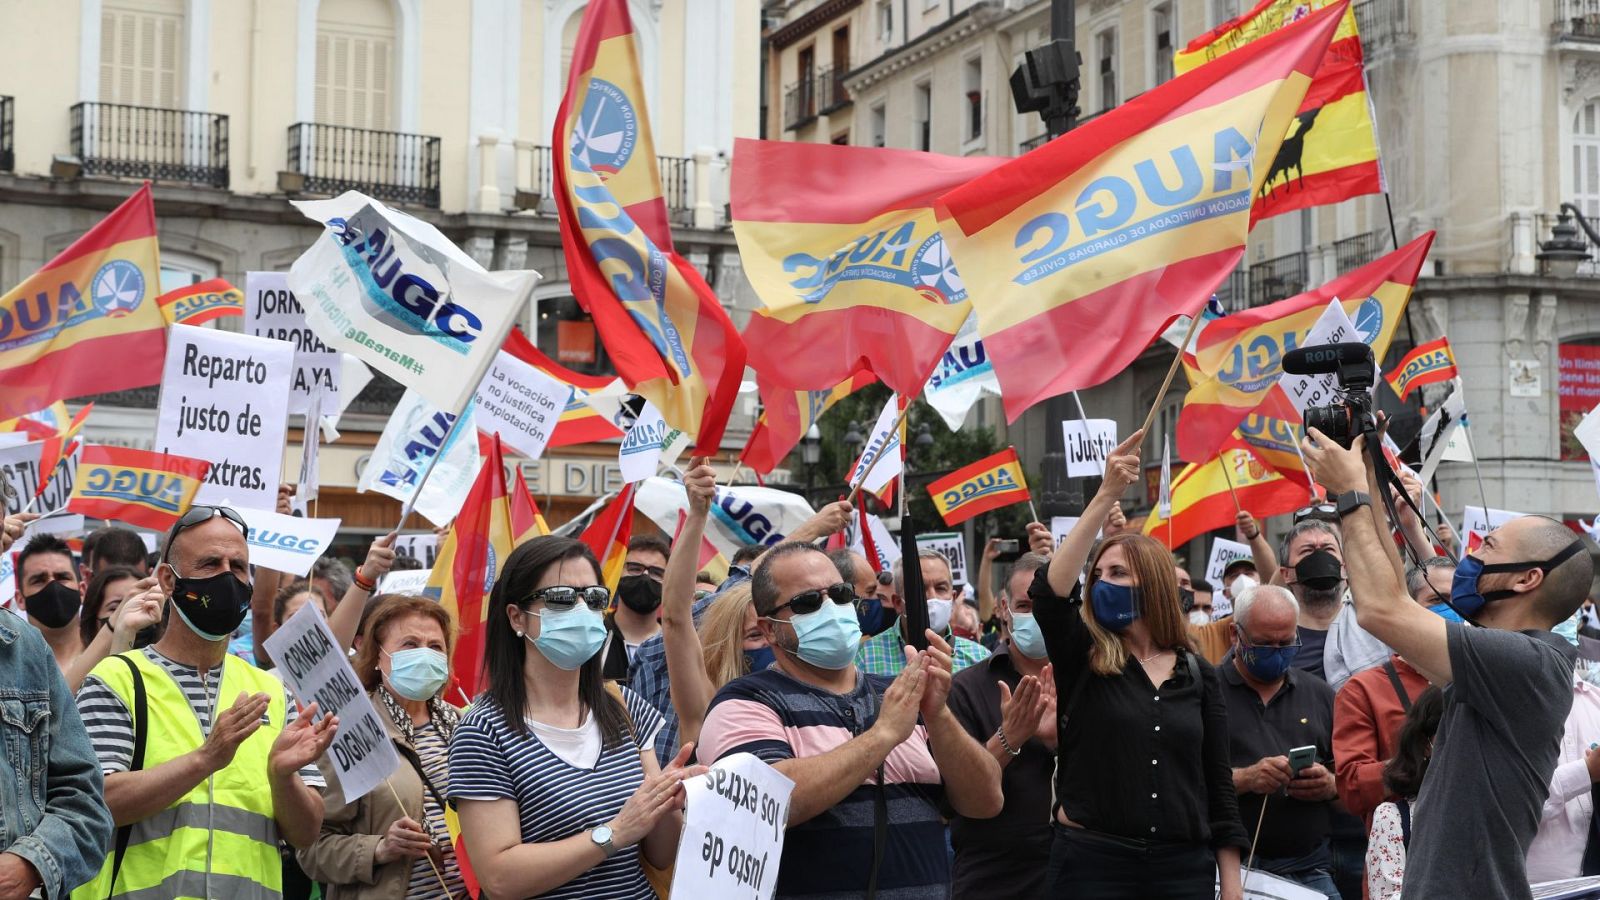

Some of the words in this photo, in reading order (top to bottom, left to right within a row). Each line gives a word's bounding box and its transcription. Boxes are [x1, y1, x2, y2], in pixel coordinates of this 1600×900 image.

[174, 291, 240, 316] AUGC
[255, 289, 305, 320] JORN
[353, 227, 483, 343] AUGC
[182, 343, 267, 389] Reparto
[943, 340, 986, 376] AU
[488, 384, 502, 397] no
[500, 390, 546, 424] justifica
[491, 365, 506, 382] La
[507, 377, 556, 411] vocación
[1293, 379, 1308, 398] La
[1306, 390, 1321, 407] no
[177, 395, 230, 438] justo
[236, 403, 262, 437] de
[483, 399, 546, 443] explotación.
[198, 457, 266, 491] extras.
[281, 622, 334, 690] JORNADA
[761, 793, 780, 842] los
[702, 831, 724, 878] de
